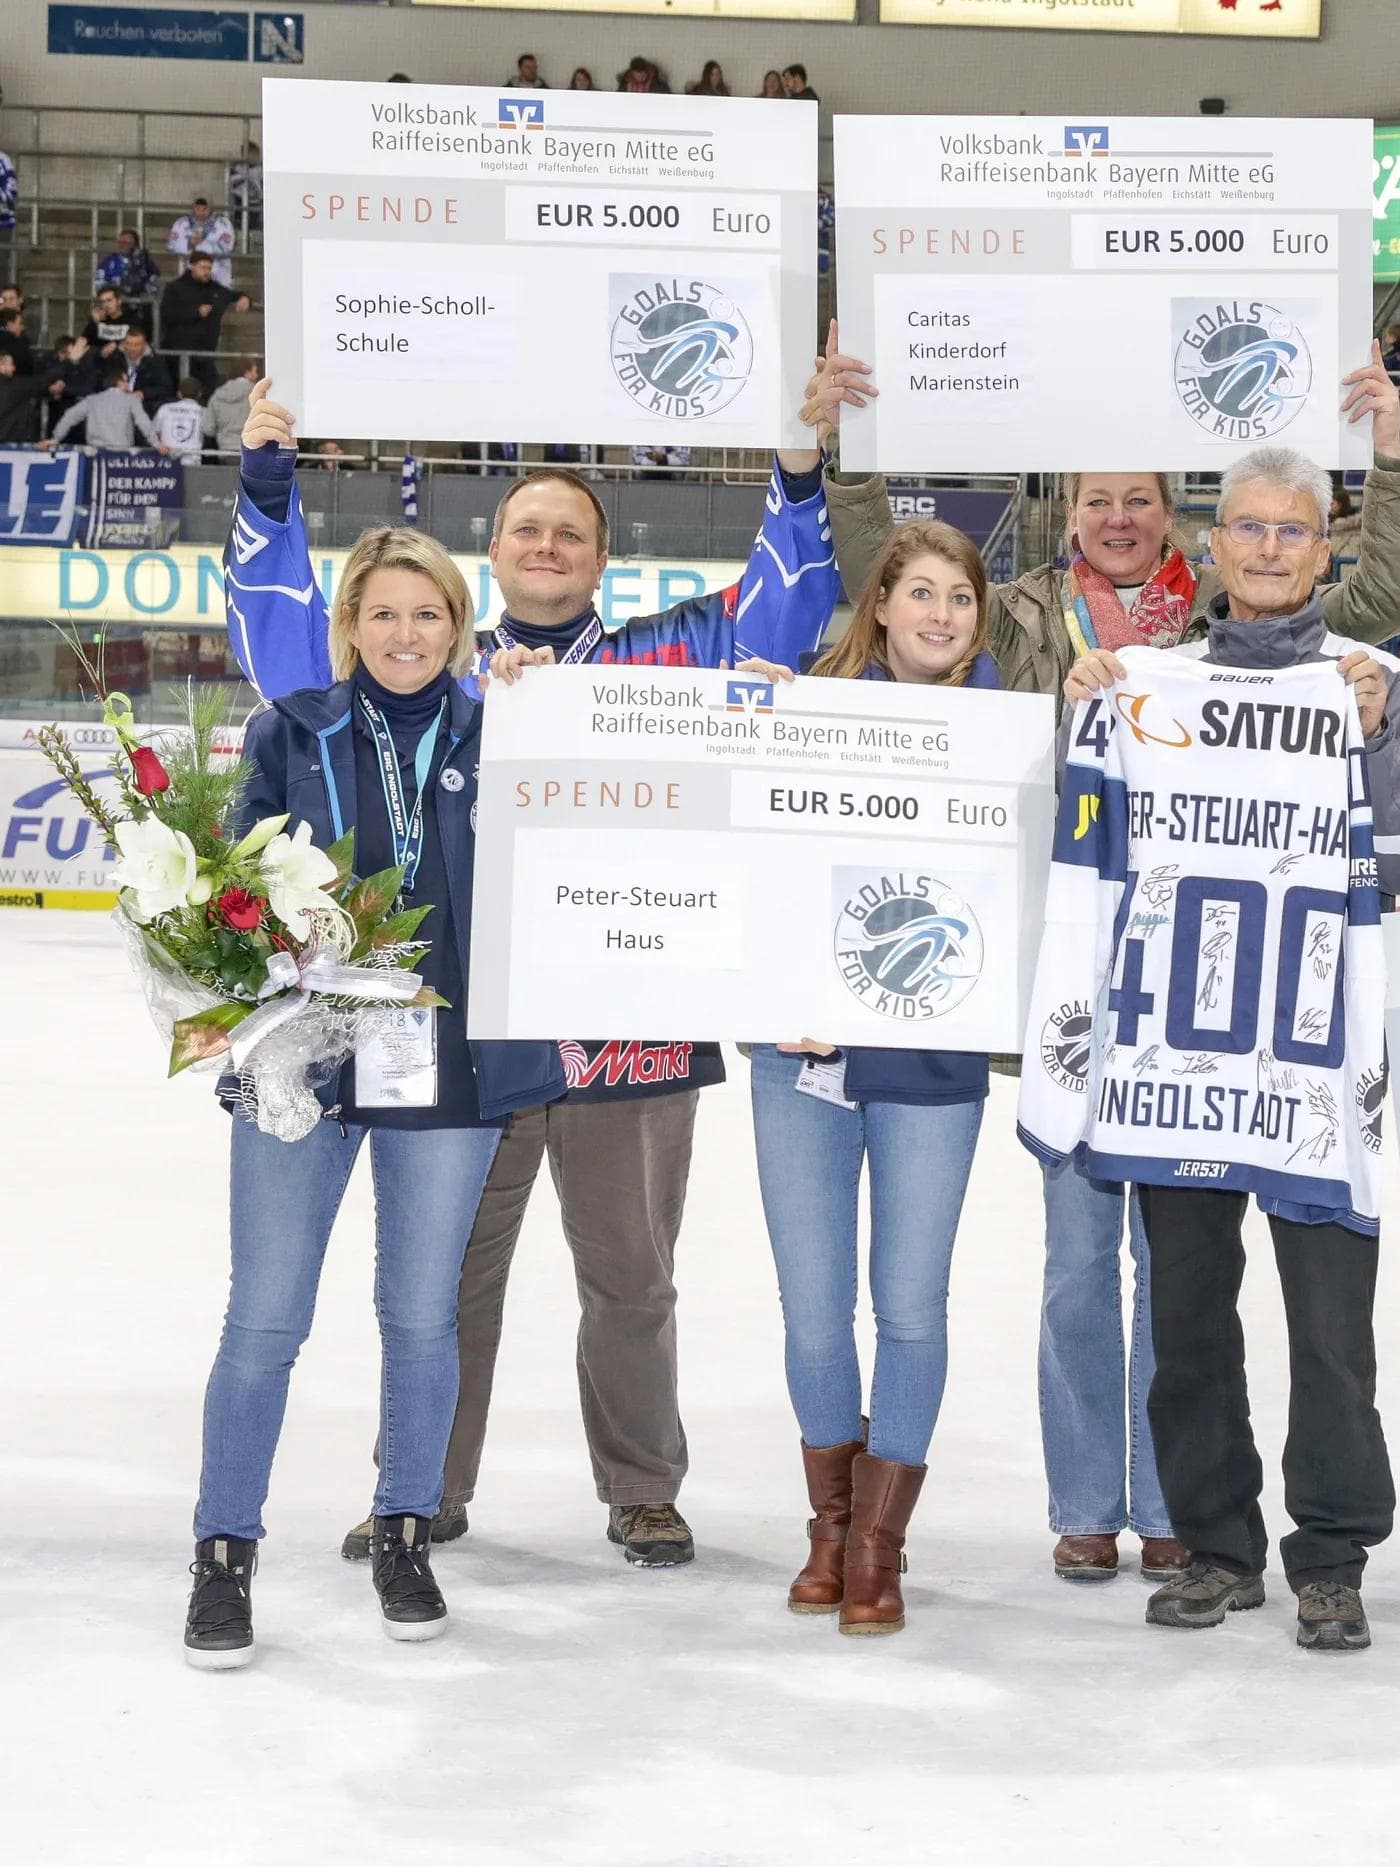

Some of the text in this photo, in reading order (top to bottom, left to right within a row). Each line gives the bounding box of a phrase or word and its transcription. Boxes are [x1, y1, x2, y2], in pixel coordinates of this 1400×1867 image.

[150, 22, 223, 43] verboten
[371, 102, 477, 127] Volksbank
[371, 131, 714, 163] Raiffeisenbank Bayern Mitte eG
[940, 135, 1043, 156] Volksbank
[480, 160, 715, 180] Ingolstadt Pfaffenhofen Eichstätt Weißenburg
[940, 162, 1274, 190] Raiffeisenbank Bayern Mitte eG
[301, 194, 460, 225] SPENDE
[1047, 189, 1275, 202] Ingolstadt Pfaffenhofen Eichstätt Weißenburg
[536, 203, 772, 235] EUR 5.000 Euro
[872, 228, 1026, 256] SPENDE
[1105, 229, 1329, 255] EUR 5.000 Euro
[335, 293, 496, 319] Sophie-Scholl-
[619, 279, 704, 326] GOALS
[908, 310, 971, 329] Caritas
[1182, 300, 1263, 350] GOALS
[335, 331, 410, 354] Schule
[908, 340, 1007, 360] Kinderdorf
[614, 353, 705, 417] FOR KIDS
[909, 373, 1019, 392] Marienstein
[1177, 377, 1267, 439] FOR KIDS
[592, 684, 704, 708] Volksbank
[592, 712, 949, 751] Raiffeisenbank Bayern Mitte eG
[1199, 699, 1347, 758] SATUR
[706, 744, 949, 769] Ingolstadt Pfaffenhofen Eichstätt Weißenburg
[516, 780, 680, 809] SPENDE
[770, 788, 1008, 827] EUR 5.000 Euro
[556, 883, 717, 909] Peter-Steuart
[843, 872, 932, 922] GOALS
[606, 928, 664, 951] Haus
[837, 950, 934, 1018] FOR KIDS
[1049, 999, 1091, 1027] GOAL
[1098, 1077, 1302, 1144] INGOLSTADT
[1174, 1160, 1230, 1179] JER53Y
